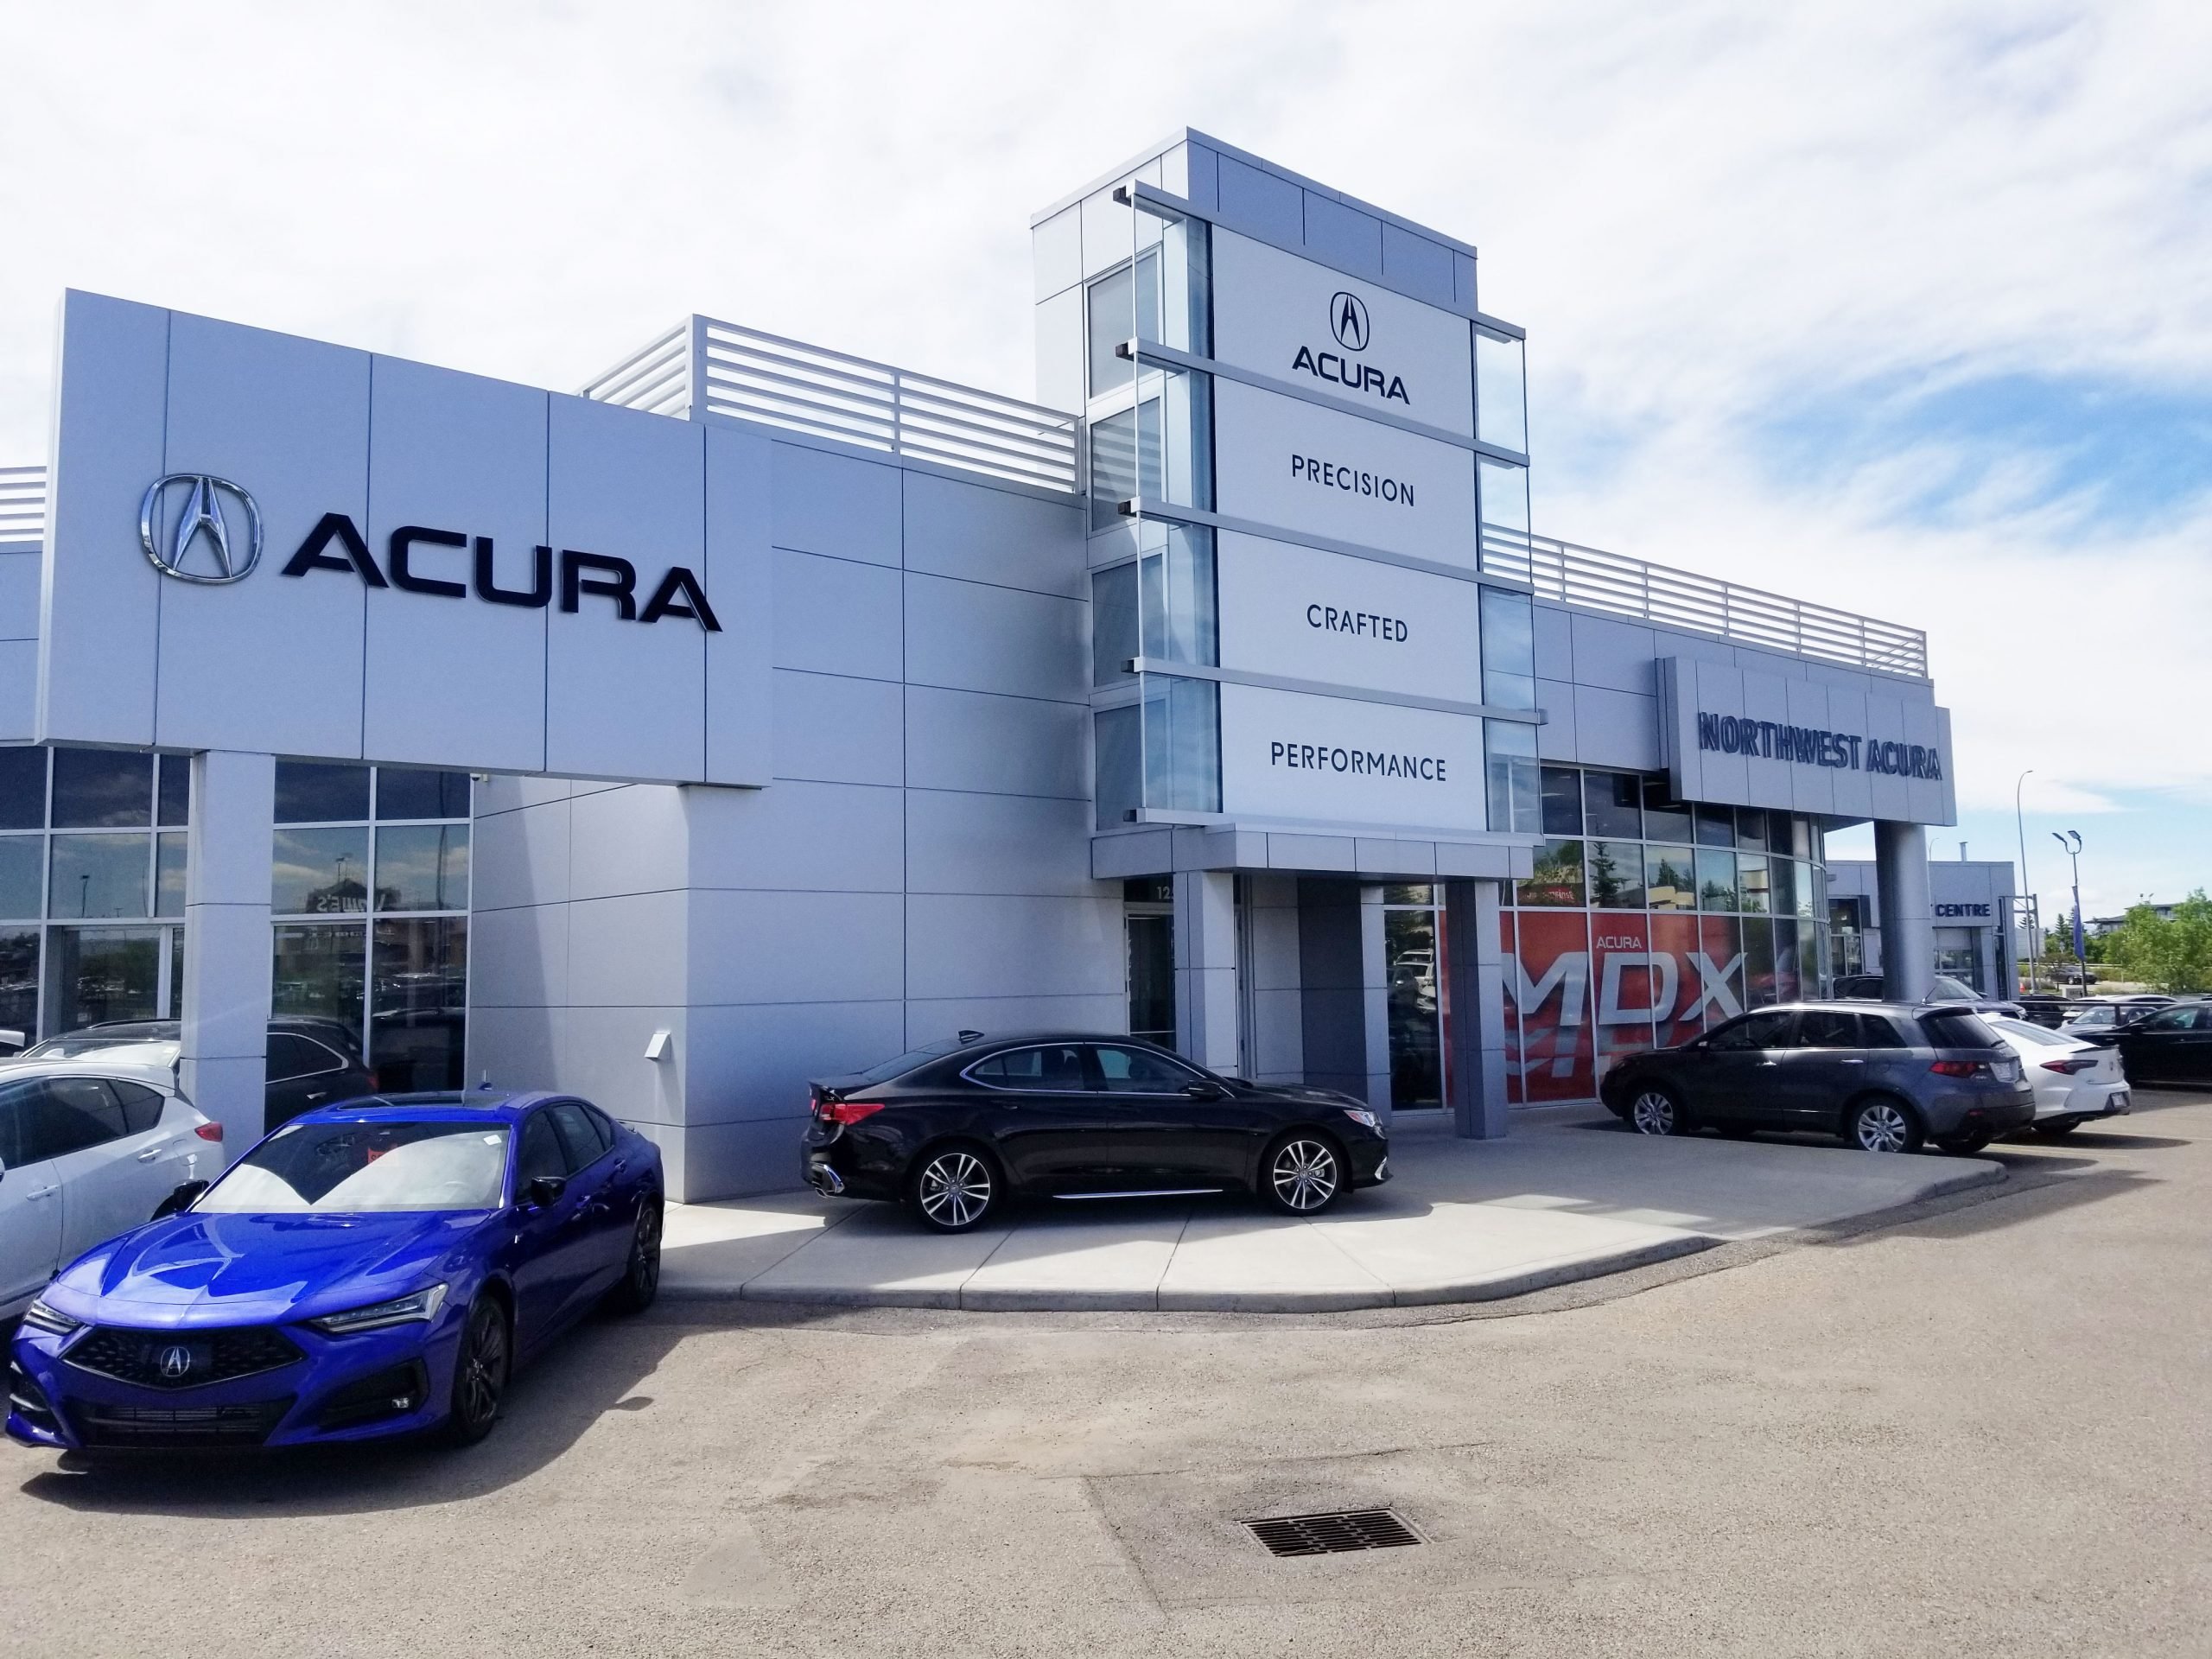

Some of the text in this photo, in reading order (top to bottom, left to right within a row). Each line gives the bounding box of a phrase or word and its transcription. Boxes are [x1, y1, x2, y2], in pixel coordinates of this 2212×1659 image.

[1292, 346, 1410, 406] ACURA
[1292, 454, 1414, 507] PRECISION
[282, 512, 722, 632] ACURA
[1306, 605, 1408, 643] CRAFTED
[1271, 741, 1446, 782] PERFORMANCE
[1699, 711, 1942, 780] NORTHWEST ACURA
[1936, 903, 1991, 917] CENTRE
[1596, 936, 1643, 950] ACURA
[1500, 952, 1748, 1027] MDX
